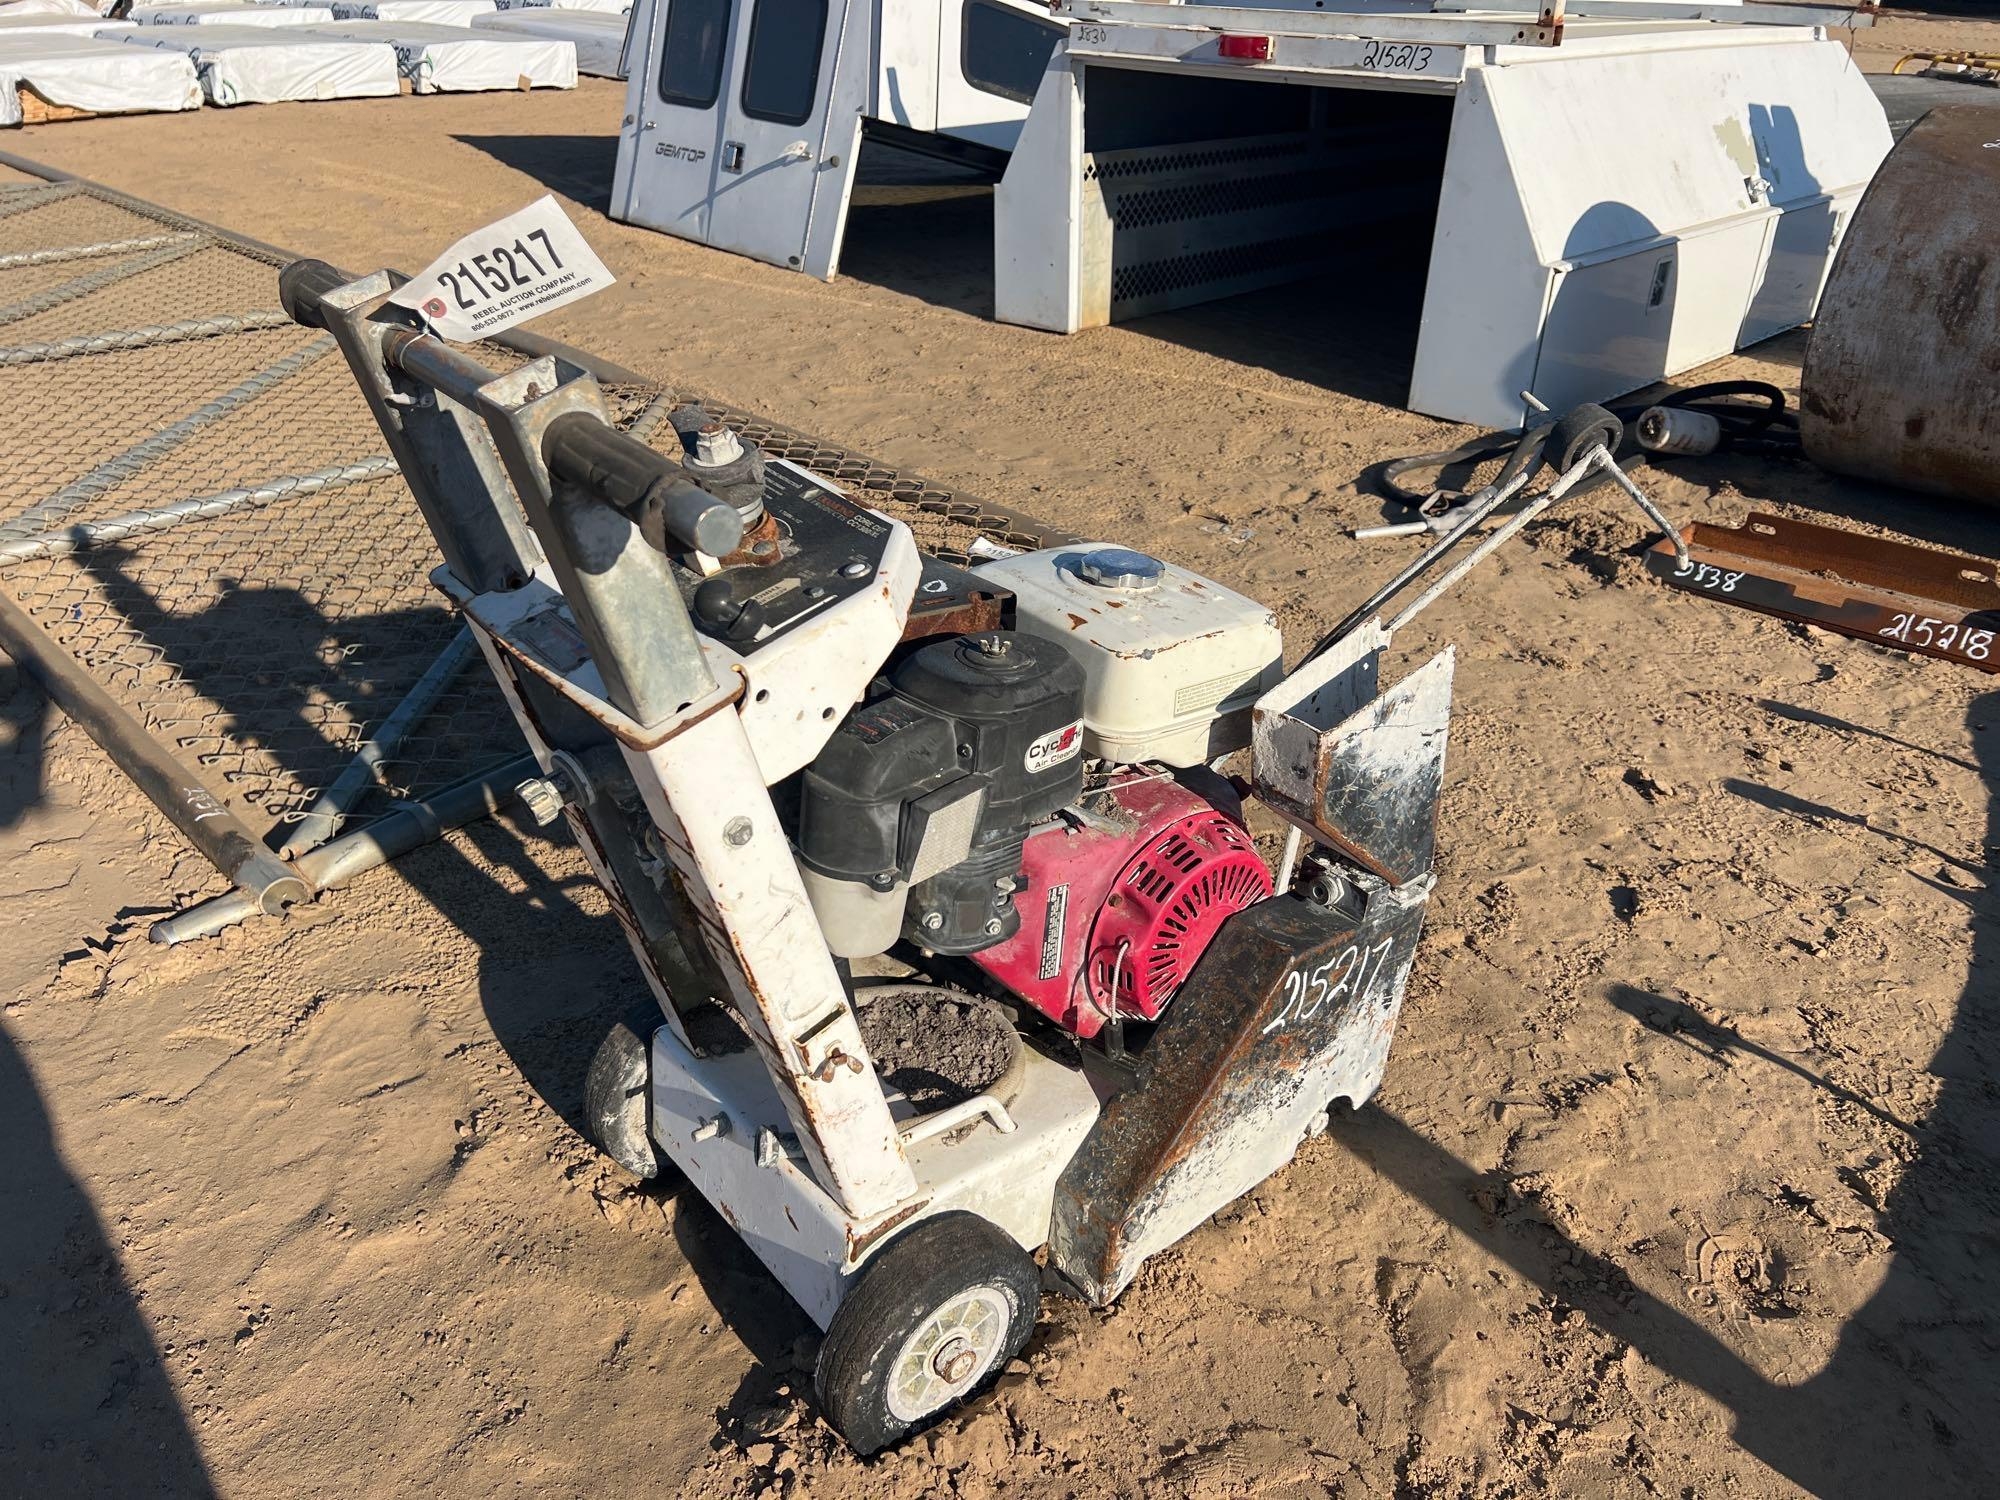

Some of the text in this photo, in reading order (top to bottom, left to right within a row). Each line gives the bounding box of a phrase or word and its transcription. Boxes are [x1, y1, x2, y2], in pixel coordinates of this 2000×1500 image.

[1363, 41, 1433, 71] 215213
[655, 142, 706, 162] GEMTOP
[437, 228, 564, 310] 215217
[471, 277, 593, 332] 800-533-0673 www.rebelauction.com
[472, 271, 577, 321] REBEL AUCTION COMPANY
[1878, 613, 1997, 660] 215218
[1262, 936, 1393, 1035] 215217
